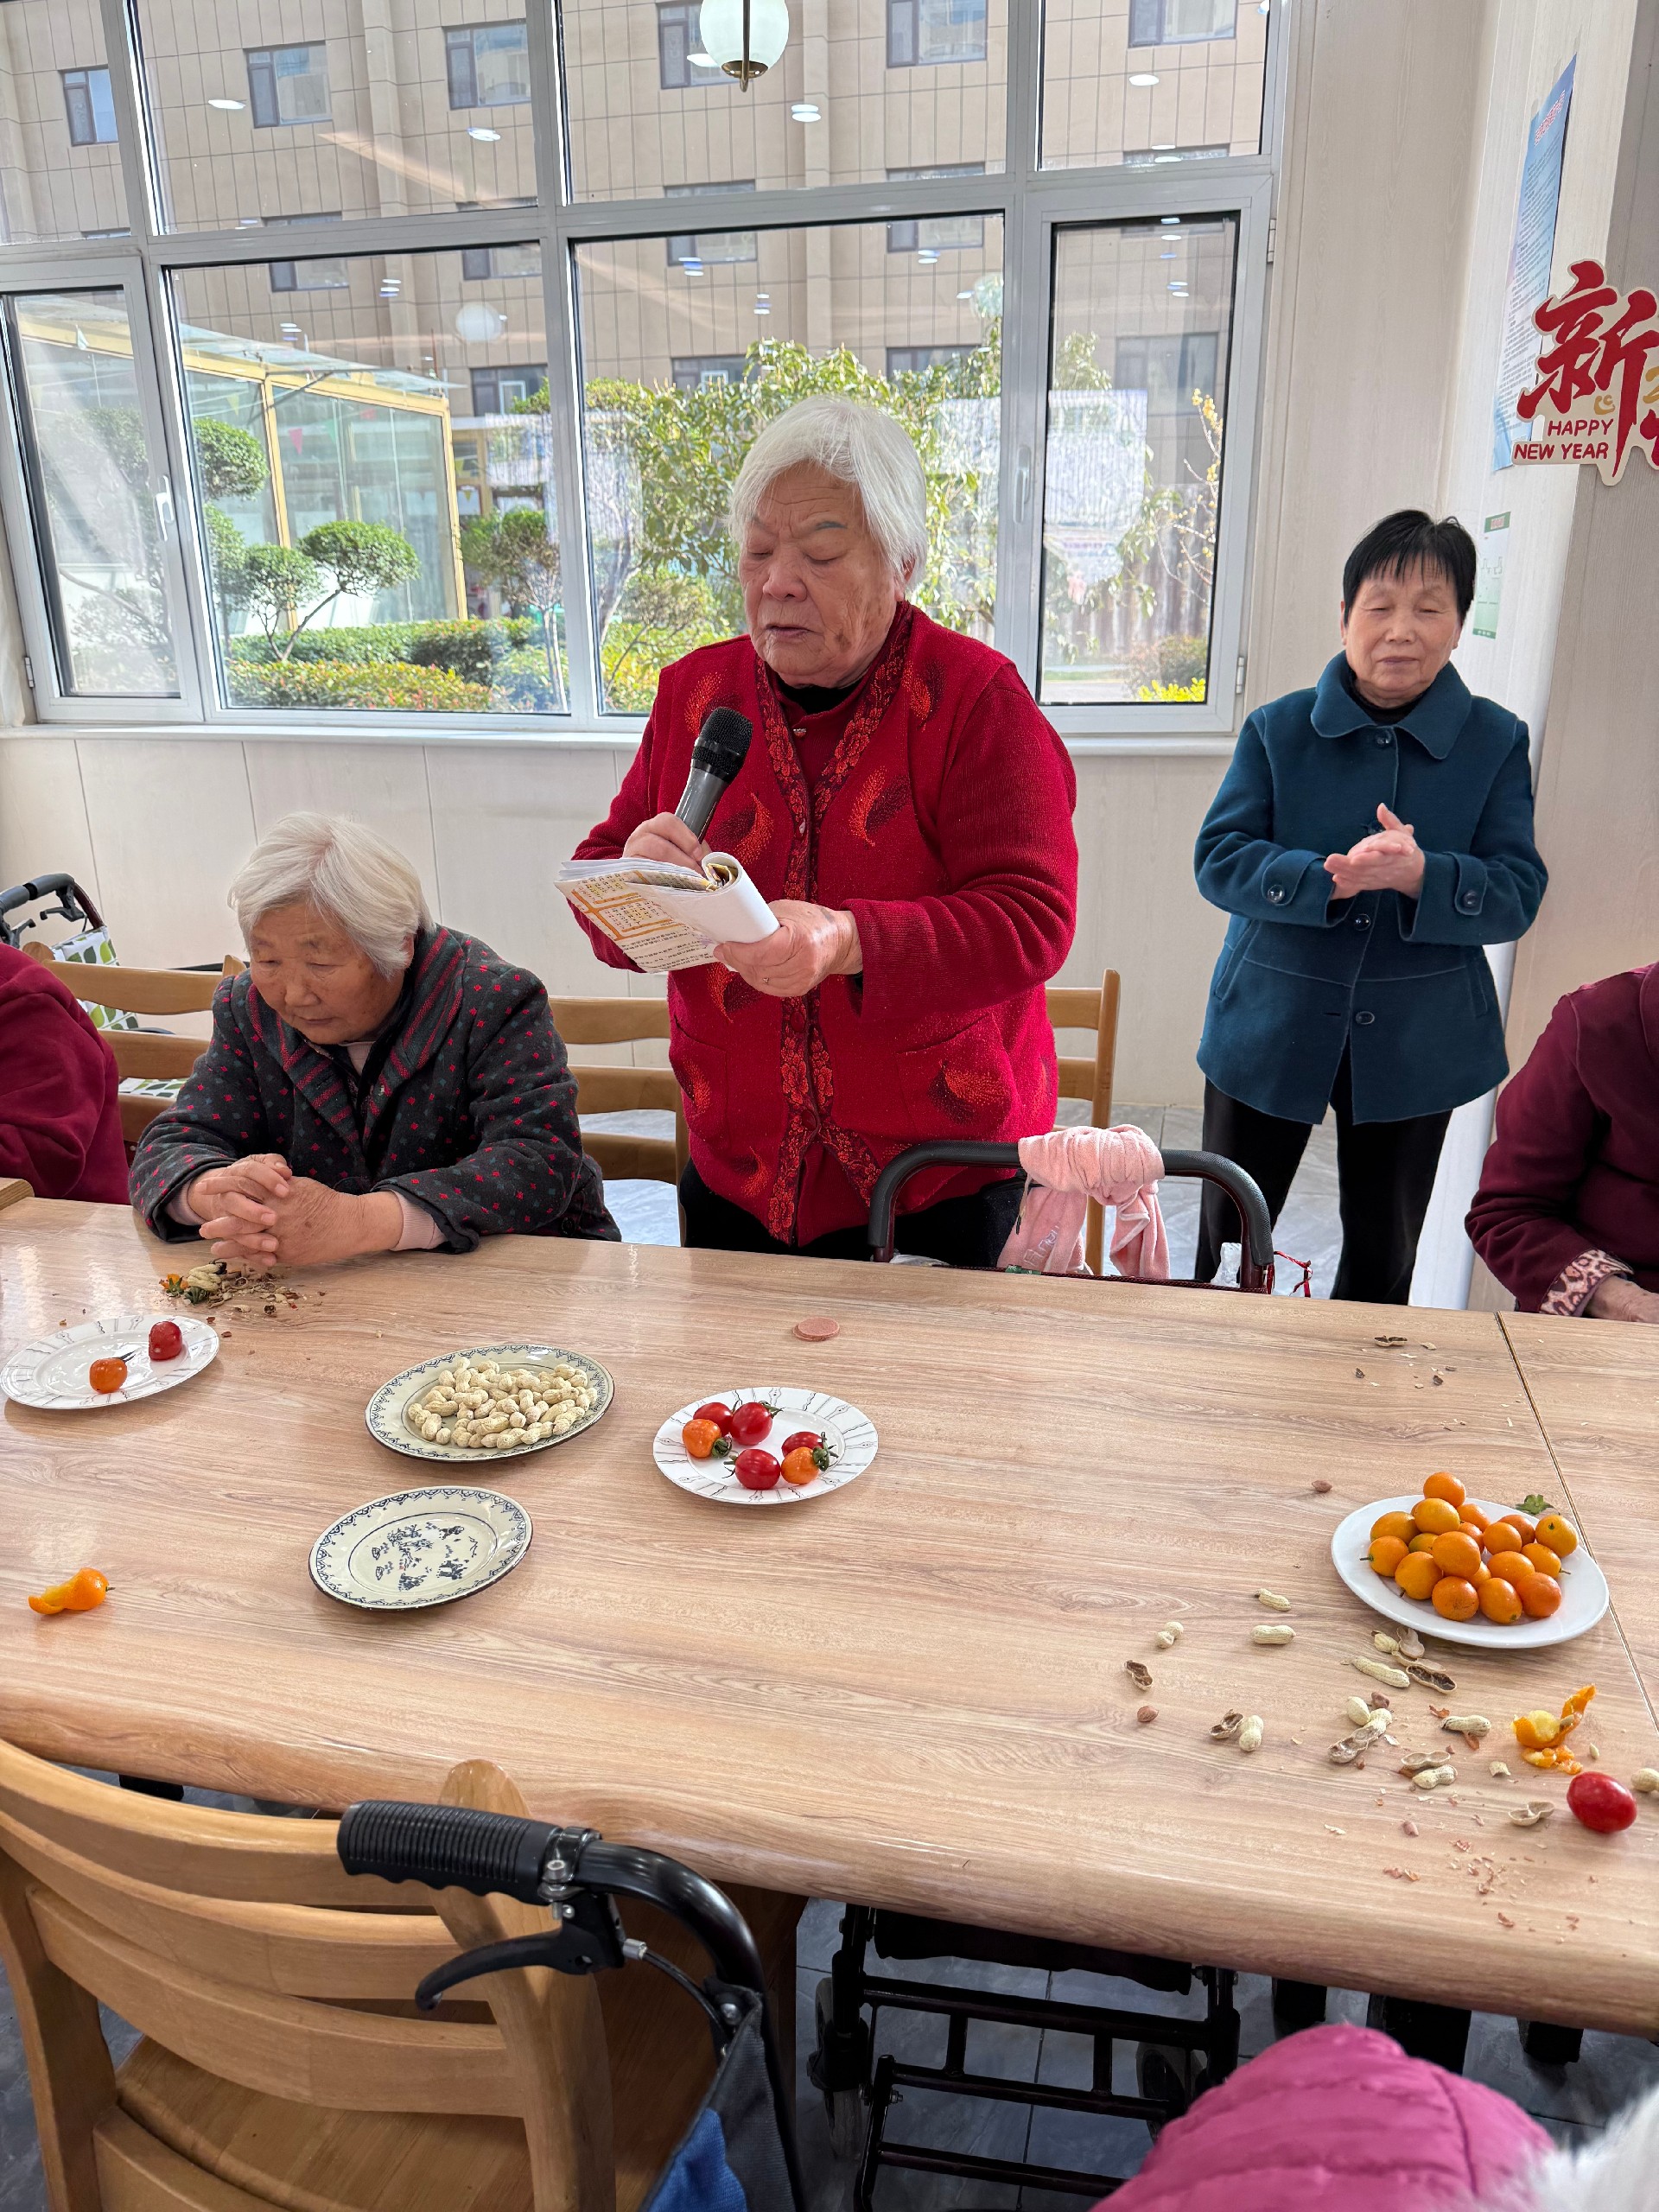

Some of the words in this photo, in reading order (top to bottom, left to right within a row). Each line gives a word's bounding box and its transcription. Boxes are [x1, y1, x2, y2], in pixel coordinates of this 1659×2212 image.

[1516, 260, 1659, 478] 新
[1548, 418, 1614, 436] HAPPY
[1514, 443, 1554, 461] NEW
[1560, 442, 1609, 460] YEAR
